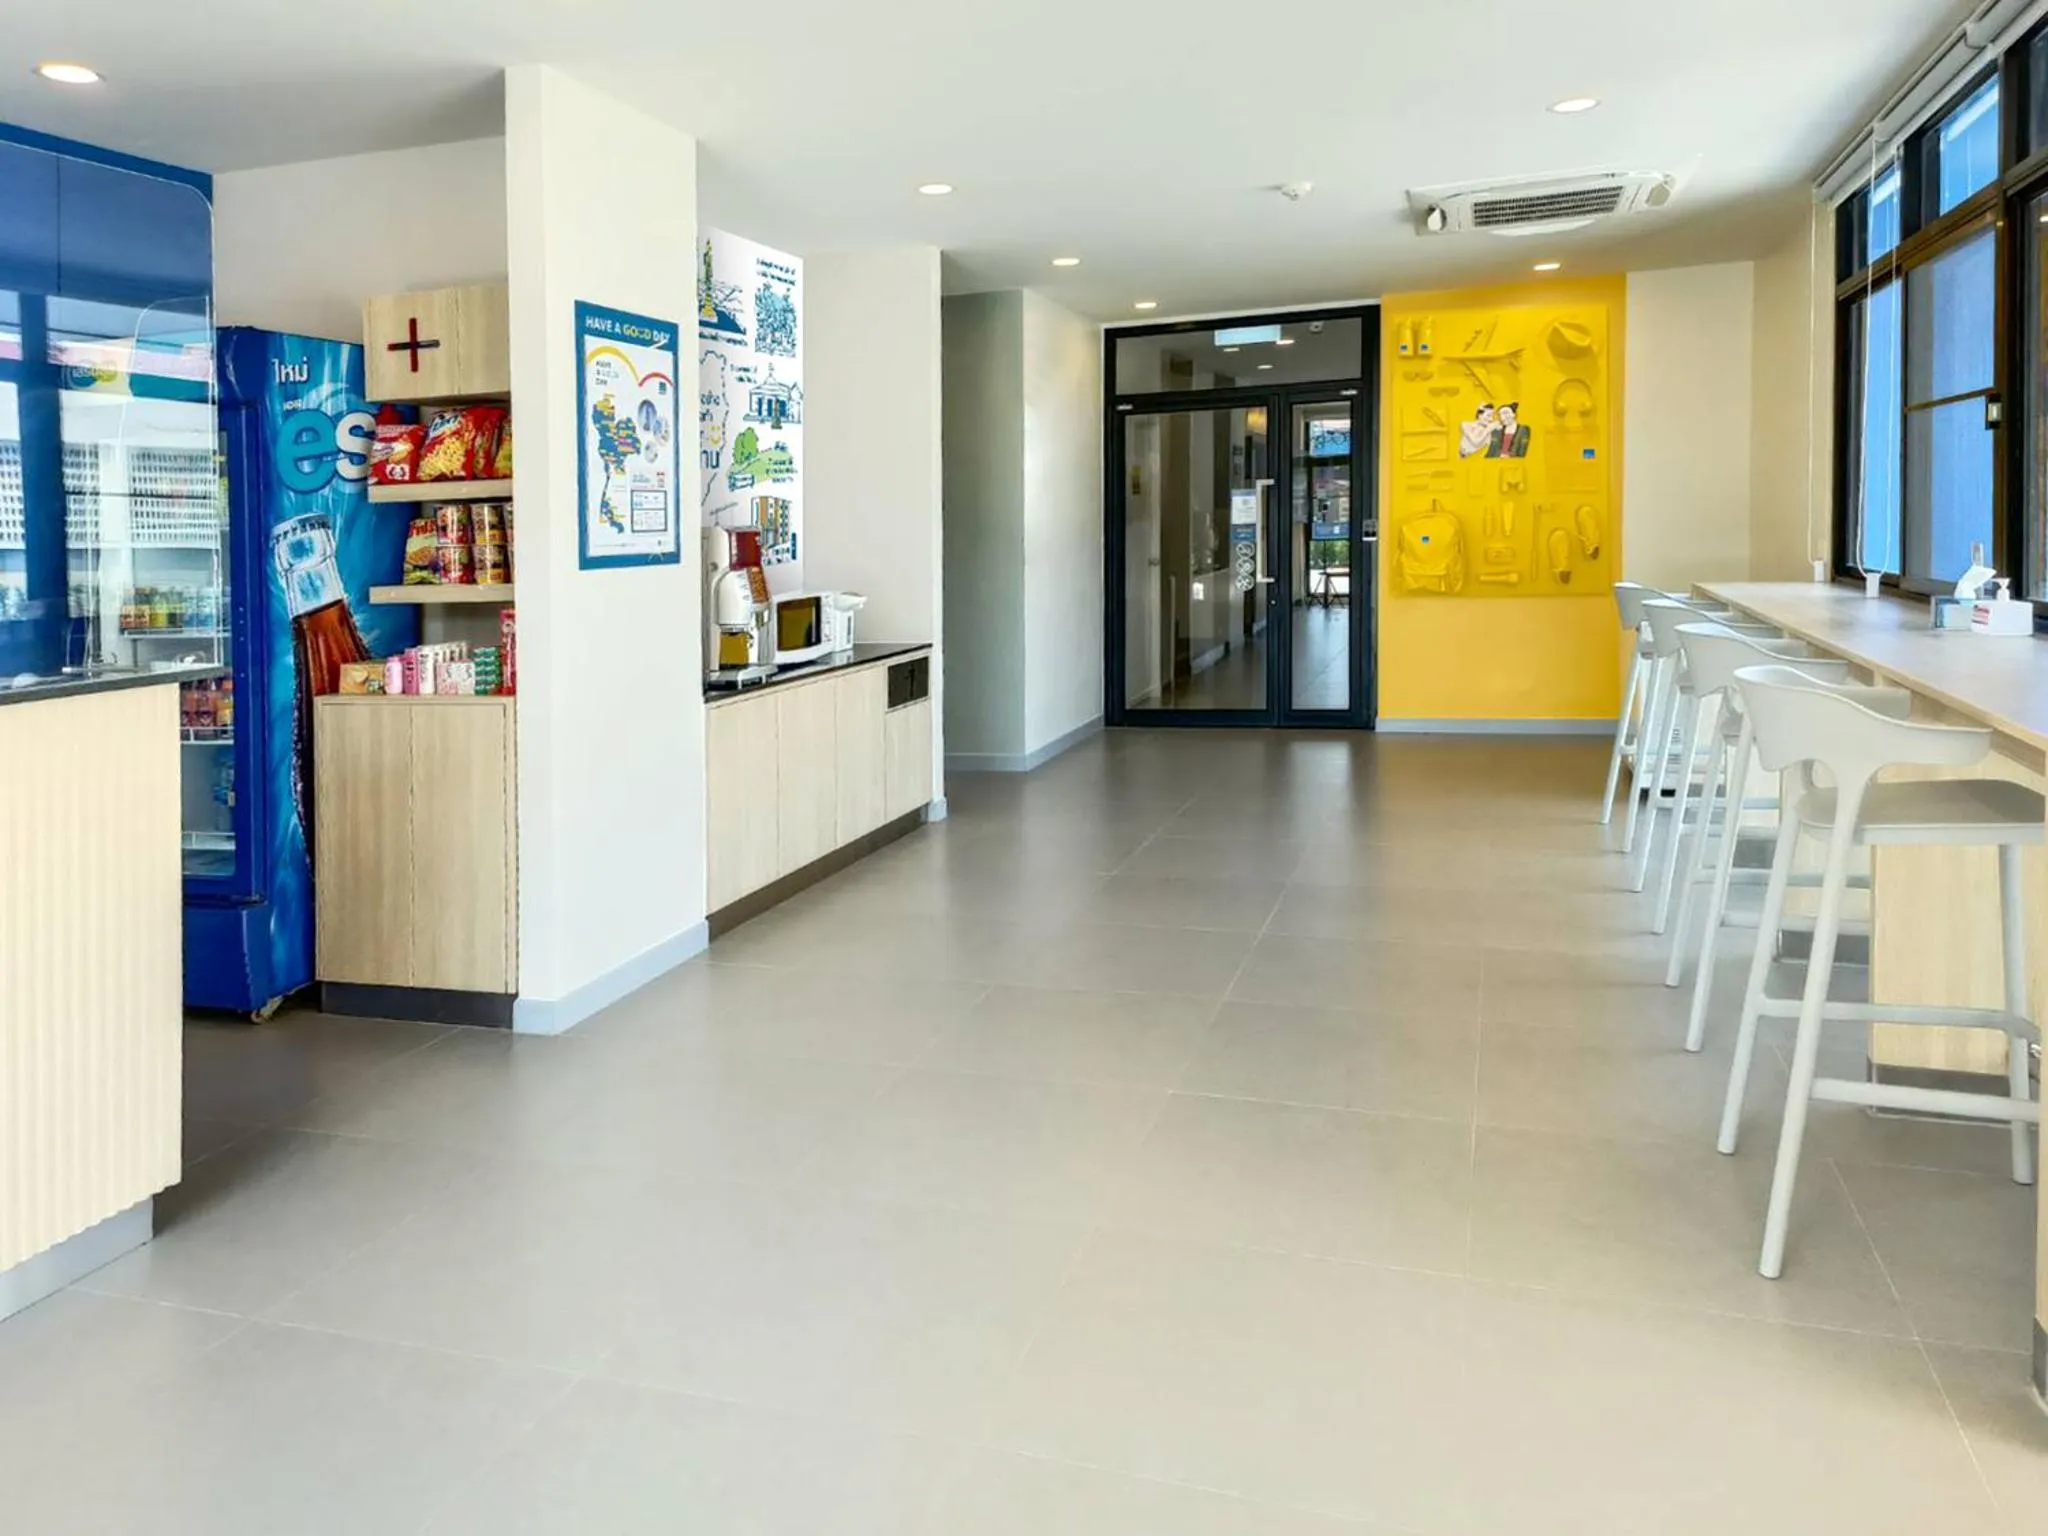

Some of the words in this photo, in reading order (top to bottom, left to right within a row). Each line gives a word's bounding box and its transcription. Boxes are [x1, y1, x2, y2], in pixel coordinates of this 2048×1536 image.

[585, 316, 612, 332] HAVE
[614, 322, 621, 334] A
[272, 356, 308, 383] ใหม่
[277, 404, 406, 491] es
